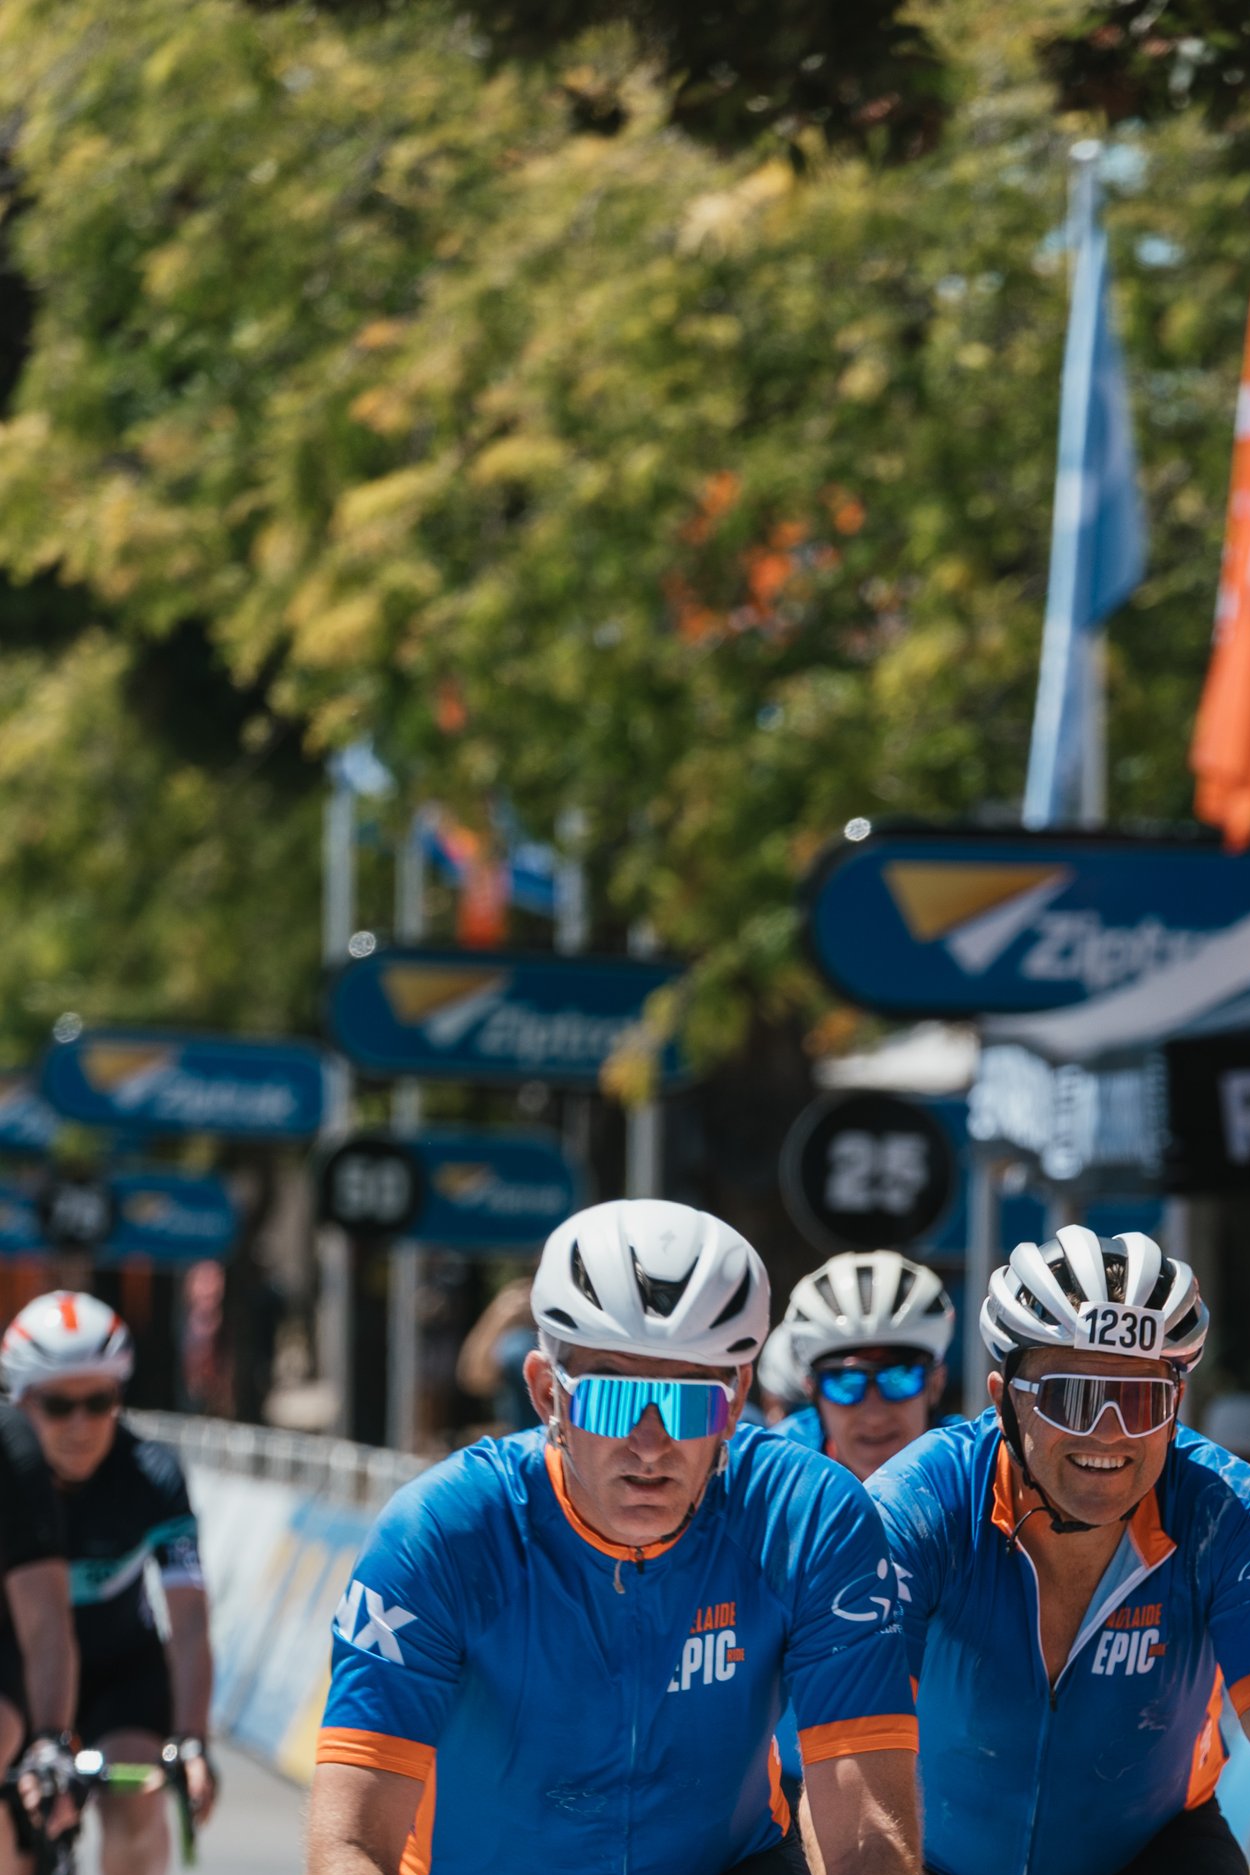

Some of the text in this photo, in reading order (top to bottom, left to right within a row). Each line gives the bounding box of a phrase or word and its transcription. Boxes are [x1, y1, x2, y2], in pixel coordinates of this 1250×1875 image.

[824, 1131, 932, 1204] 25
[1084, 1307, 1159, 1352] 1230
[1091, 1628, 1160, 1676] EPIC
